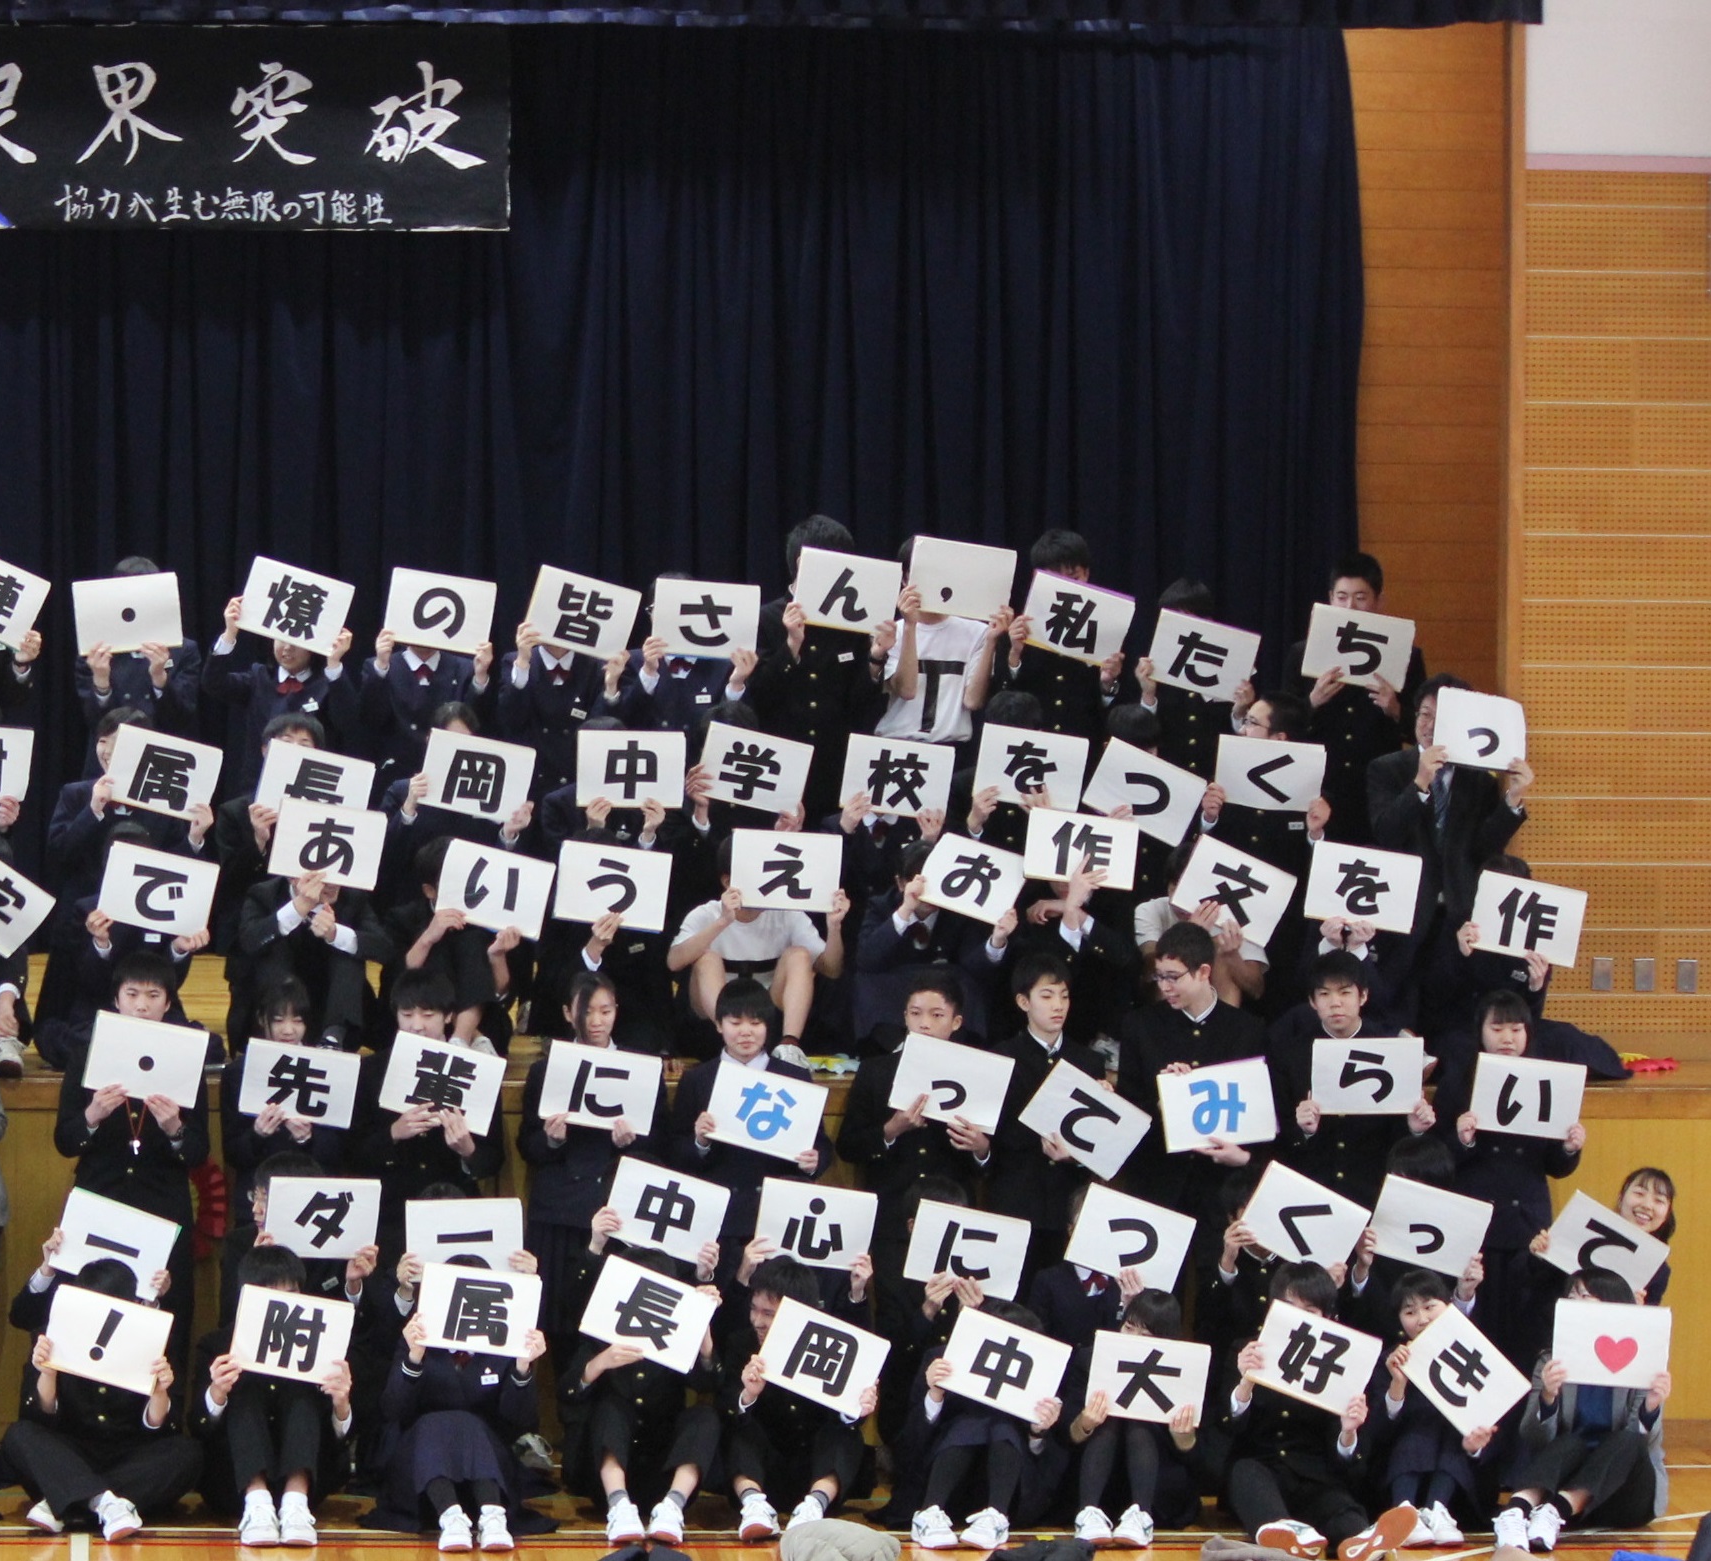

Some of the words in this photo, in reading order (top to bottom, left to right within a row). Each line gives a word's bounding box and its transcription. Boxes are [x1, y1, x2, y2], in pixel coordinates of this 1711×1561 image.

[53, 183, 394, 225] 協力が生む無限の可能性
[263, 575, 327, 639] 燎
[414, 588, 465, 638] の
[554, 583, 612, 647] 皆
[679, 595, 732, 646] さ
[819, 568, 867, 622] ん
[1046, 592, 1097, 654] 私
[1336, 621, 1388, 675] ち
[1168, 632, 1228, 687] た
[1004, 741, 1057, 794] を
[1469, 726, 1500, 757] っ
[128, 744, 195, 810] 属
[441, 750, 505, 812] 岡
[605, 741, 657, 799] 中
[719, 742, 780, 800] 学
[868, 750, 928, 811] 校
[1125, 773, 1170, 815] つ
[1247, 755, 1294, 803] く
[300, 819, 353, 875] あ
[759, 844, 811, 899] え
[1053, 822, 1112, 875] 作
[134, 865, 187, 920] で
[465, 858, 518, 910] い
[588, 859, 636, 913] う
[942, 855, 1000, 905] お
[1200, 863, 1268, 927] 文
[1336, 860, 1389, 915] を
[1499, 888, 1558, 951] 作
[266, 1055, 330, 1117] 先
[405, 1050, 477, 1116] 輩
[569, 1060, 629, 1117] に
[932, 1080, 966, 1110] っ
[1340, 1050, 1393, 1103] ら
[1497, 1074, 1551, 1126] い
[739, 1085, 793, 1138] な
[1060, 1088, 1120, 1152] て
[1192, 1081, 1244, 1132] み
[296, 1192, 353, 1248] ダ
[635, 1181, 695, 1242] 中
[781, 1199, 842, 1260] 心
[1279, 1205, 1332, 1256] く
[1410, 1224, 1444, 1254] っ
[934, 1221, 997, 1280] に
[1109, 1219, 1158, 1266] つ
[1577, 1218, 1639, 1270] て
[90, 1311, 120, 1359] ！
[257, 1301, 325, 1371] 附
[443, 1279, 512, 1345] 属
[616, 1279, 682, 1349] 長
[783, 1322, 858, 1396] 岡
[971, 1337, 1033, 1399] 中
[1116, 1350, 1181, 1413] 大
[1279, 1323, 1350, 1393] 好
[1430, 1341, 1489, 1406] き
